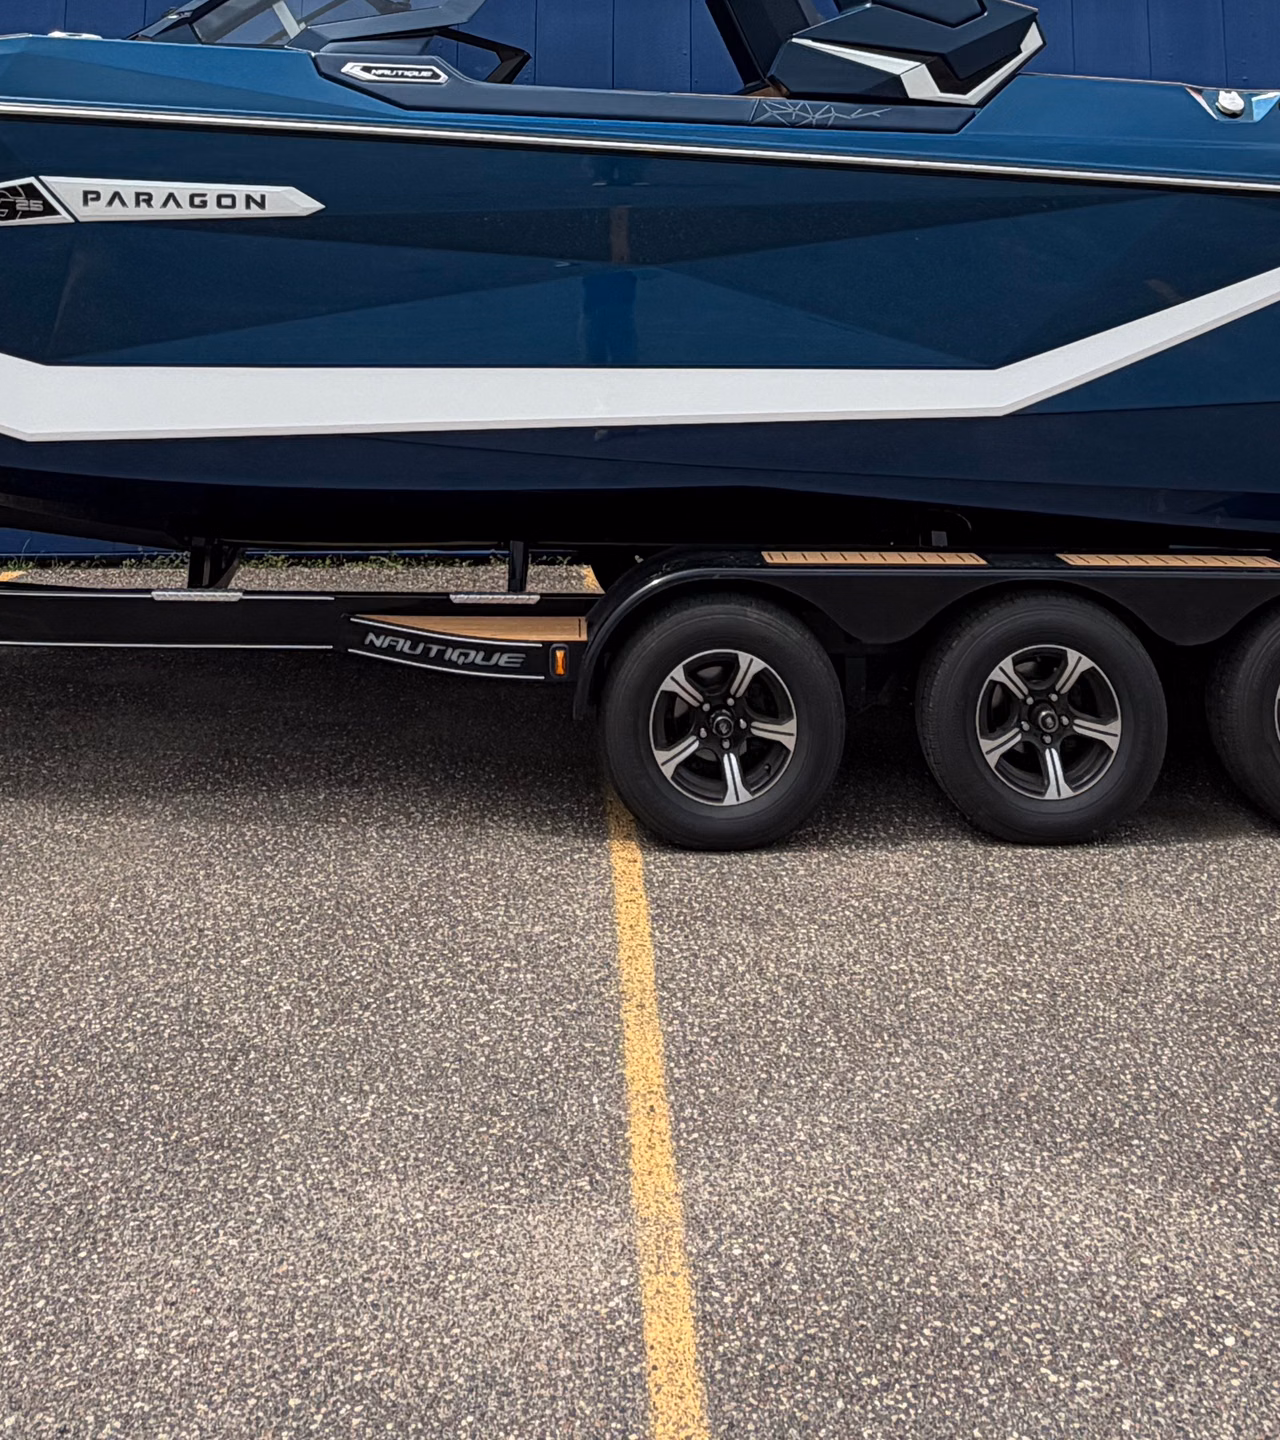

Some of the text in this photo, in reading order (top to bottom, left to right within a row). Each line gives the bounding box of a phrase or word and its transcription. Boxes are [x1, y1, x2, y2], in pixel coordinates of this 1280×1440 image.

[370, 69, 434, 77] NAUTIQUE
[82, 190, 268, 211] PARAGON
[364, 632, 526, 667] NAUTIQUE
